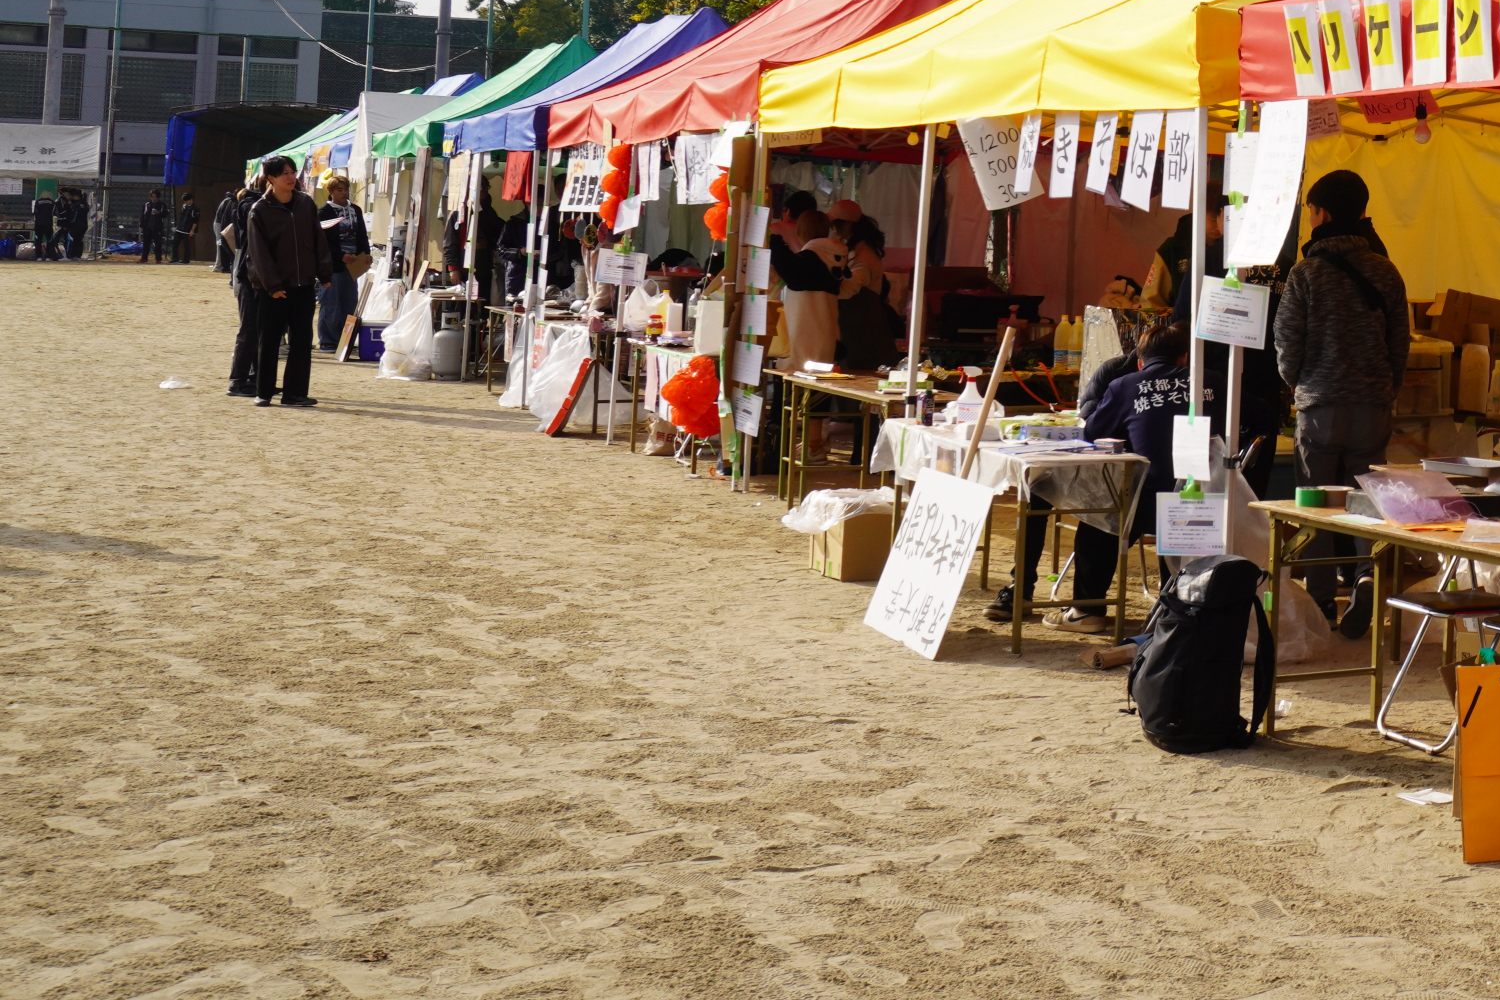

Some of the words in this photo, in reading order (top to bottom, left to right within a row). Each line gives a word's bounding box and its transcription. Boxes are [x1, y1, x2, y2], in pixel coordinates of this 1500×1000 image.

[980, 127, 1019, 153] 1,200
[1020, 119, 1191, 183] 焼きそば部
[1136, 377, 1191, 395] 京都大
[895, 491, 982, 575] 焼きそば部
[885, 579, 946, 652] 京都大学
